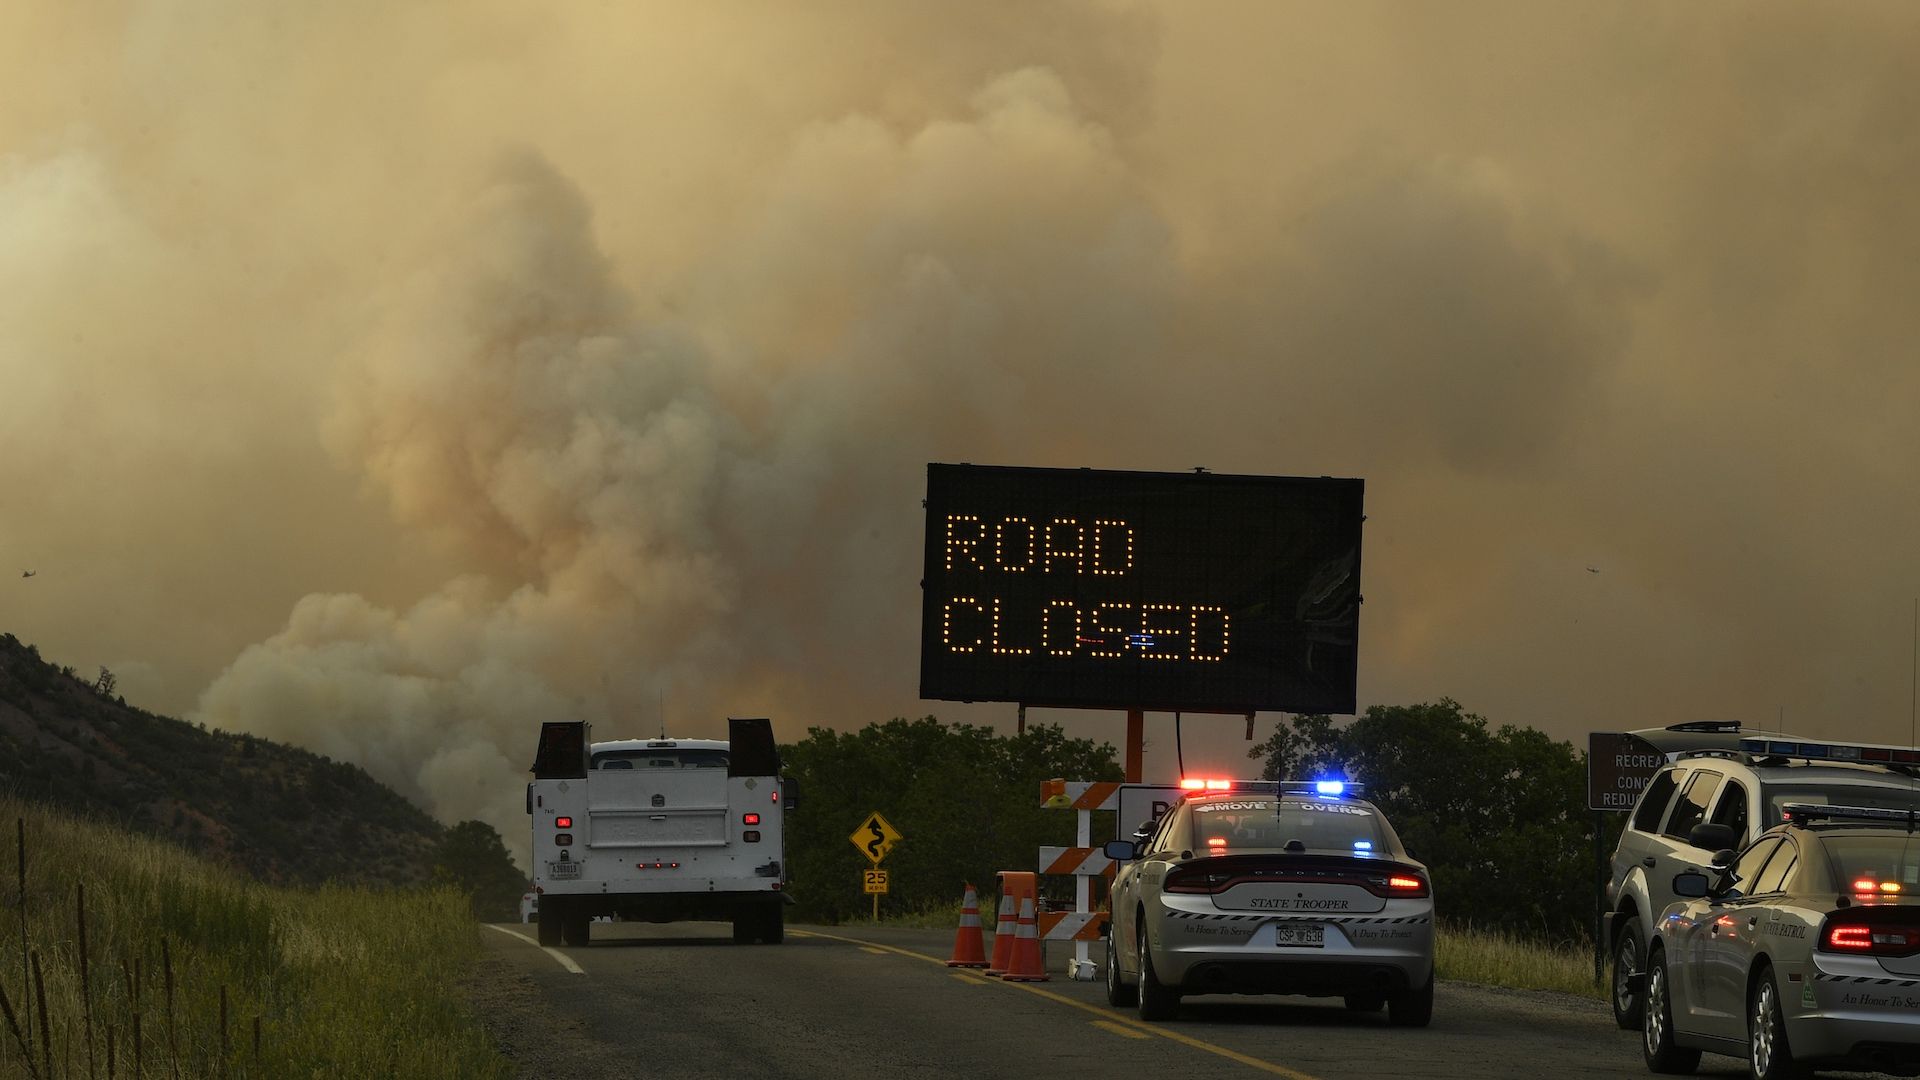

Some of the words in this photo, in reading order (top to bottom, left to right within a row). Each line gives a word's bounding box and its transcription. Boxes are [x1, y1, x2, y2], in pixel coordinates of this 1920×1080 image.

[945, 514, 1134, 576] ROAD
[943, 597, 1230, 662] CLOSED
[1215, 803, 1266, 811] MOVE
[1302, 804, 1353, 814] OVER
[867, 873, 886, 884] 25
[1251, 899, 1288, 908] STATE
[1294, 899, 1348, 910] TROOPER
[1184, 924, 1194, 933] An
[1196, 924, 1217, 934] Honor
[1219, 926, 1229, 935] To
[1360, 929, 1377, 940] Duty
[1380, 930, 1389, 938] To
[1779, 924, 1806, 939] PATROL
[1280, 930, 1294, 941] CSP
[1841, 993, 1857, 1003] An
[1860, 994, 1889, 1006] Honor
[1890, 996, 1903, 1007] To
